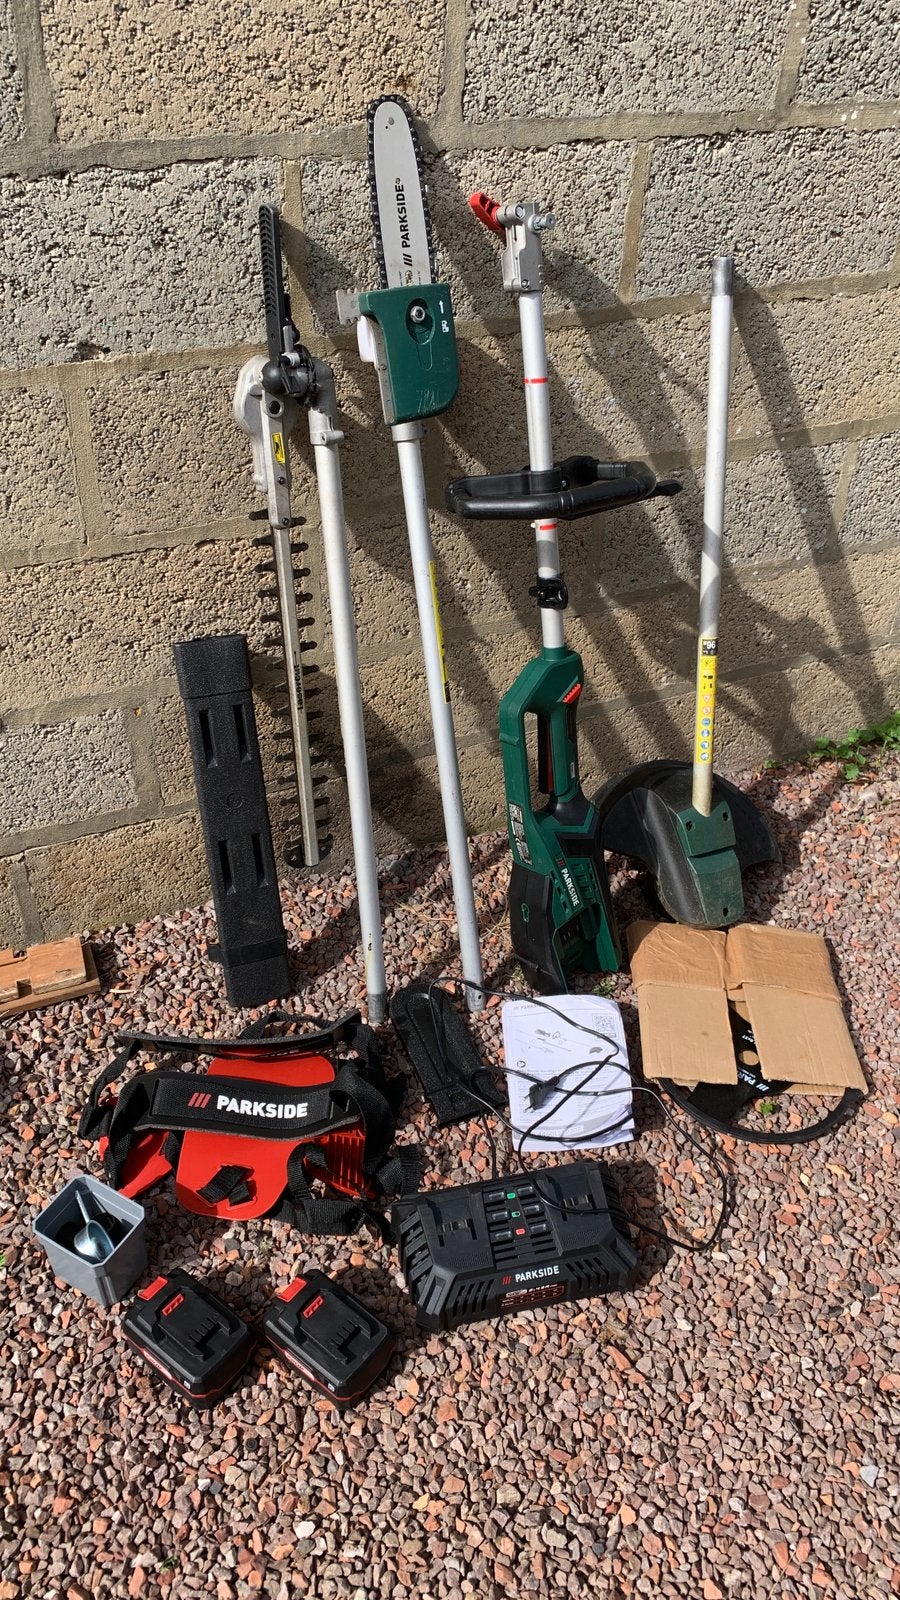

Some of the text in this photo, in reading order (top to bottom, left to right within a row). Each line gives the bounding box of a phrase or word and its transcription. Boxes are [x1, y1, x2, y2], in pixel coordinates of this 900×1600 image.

[561, 867, 580, 907] PARKSIDE
[216, 1094, 309, 1119] PARKSIDE
[515, 1265, 560, 1283] PARKSIDE
